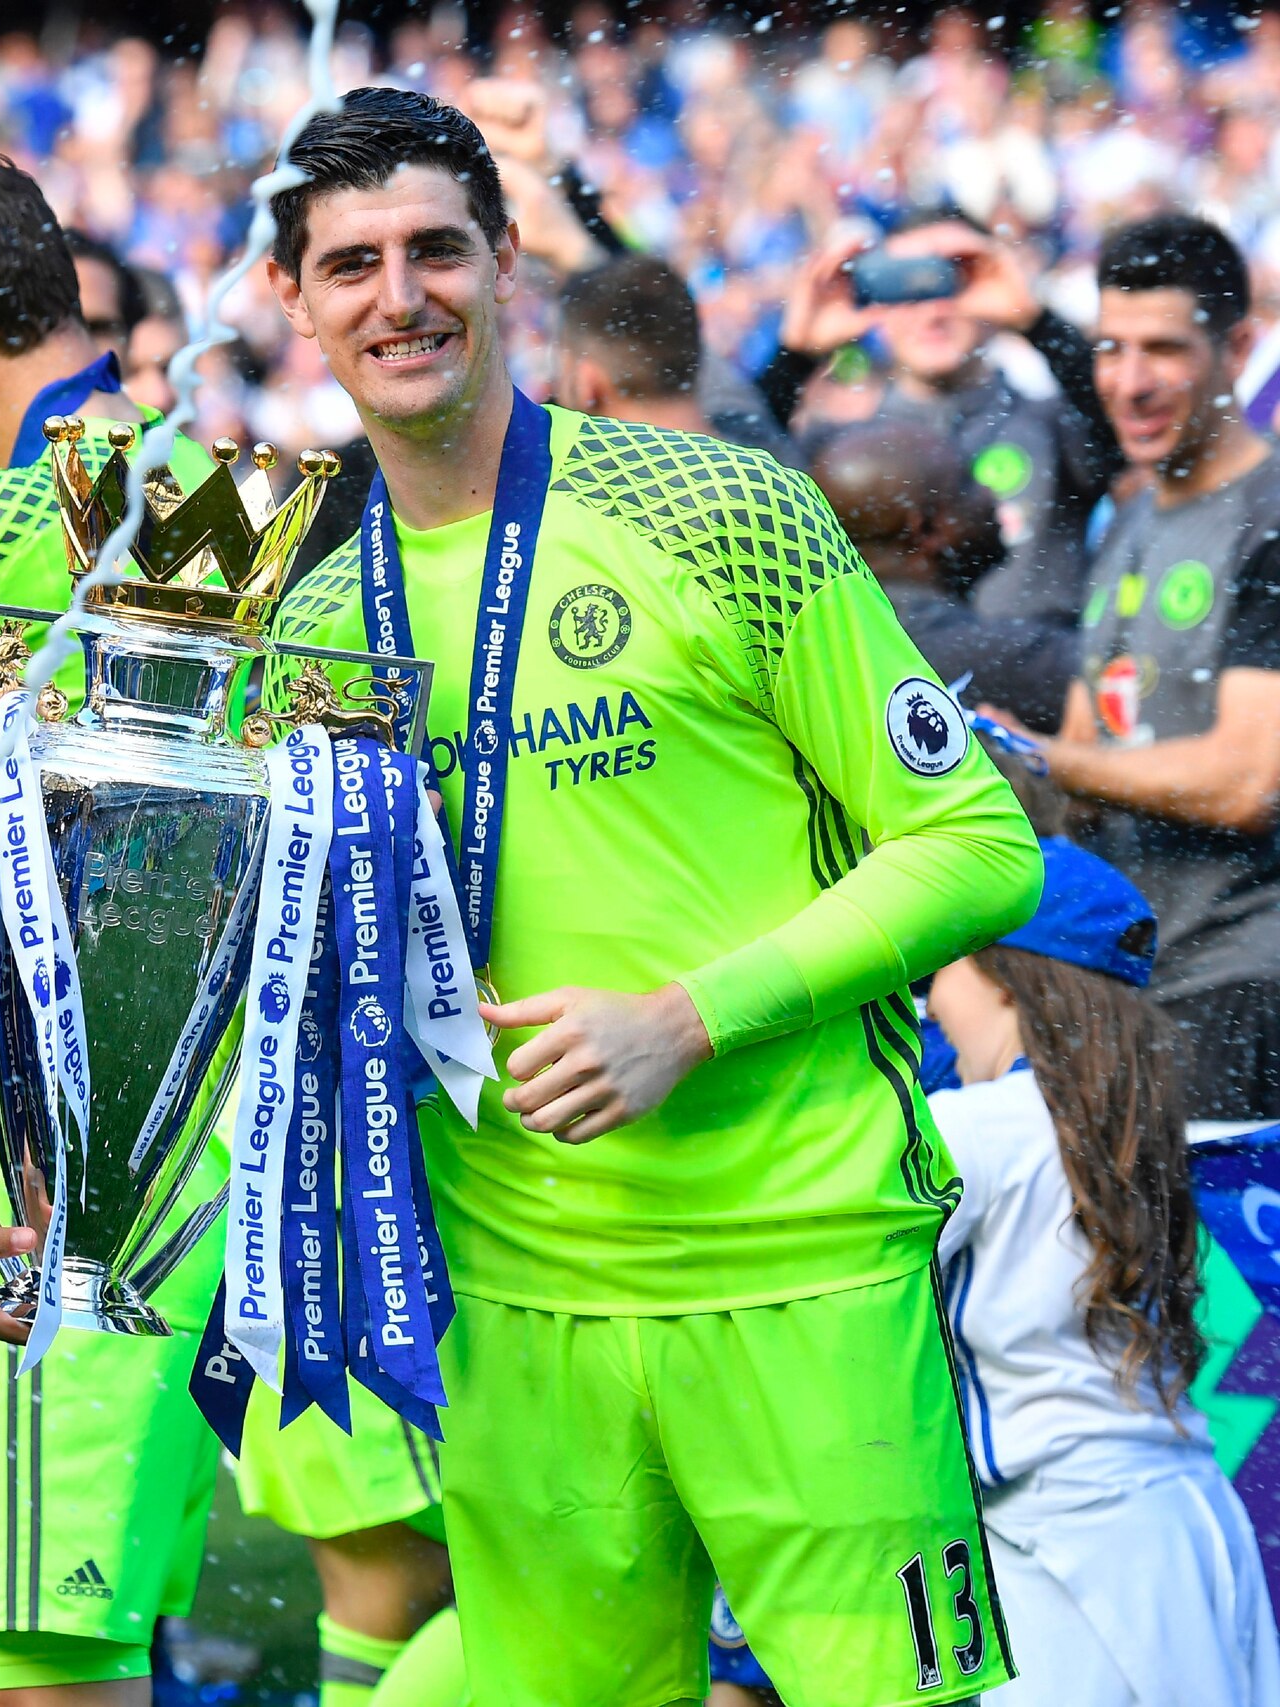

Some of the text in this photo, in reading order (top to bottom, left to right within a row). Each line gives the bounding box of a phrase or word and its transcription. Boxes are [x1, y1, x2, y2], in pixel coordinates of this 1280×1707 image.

[370, 501, 390, 589] Premier
[559, 585, 616, 609] CHELSEA
[476, 522, 523, 712] Premier League
[563, 644, 621, 667] FOOTBALL CLUB
[467, 760, 494, 854] League
[545, 739, 657, 791] TYRES
[897, 734, 943, 770] Premier League
[2, 812, 44, 949] Premier
[267, 729, 320, 964] Premier League
[334, 738, 380, 985] Premier League
[411, 893, 462, 1020] Premier
[238, 1035, 286, 1320] Premier League
[362, 1057, 398, 1201] League
[291, 1071, 330, 1362] Premier League
[371, 1207, 415, 1346] Premier
[56, 1583, 114, 1601] adidas
[896, 1538, 984, 1690] 13
